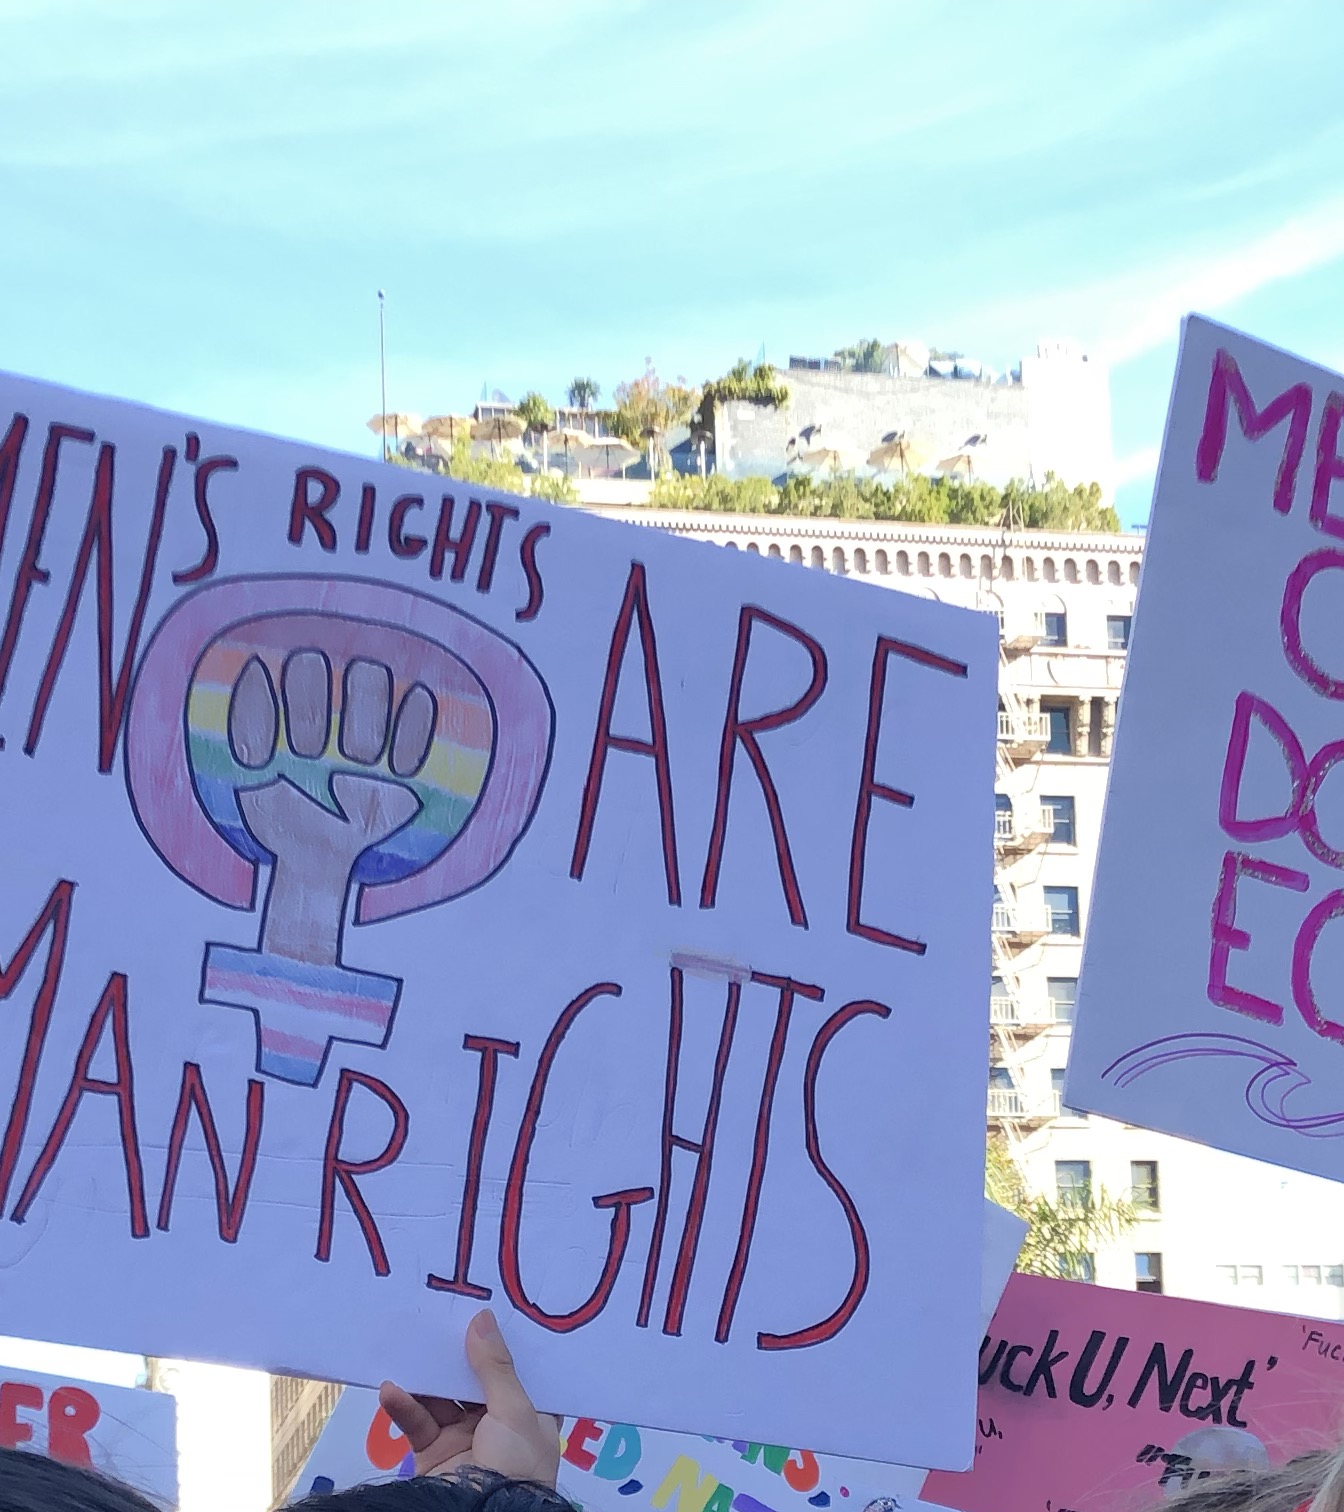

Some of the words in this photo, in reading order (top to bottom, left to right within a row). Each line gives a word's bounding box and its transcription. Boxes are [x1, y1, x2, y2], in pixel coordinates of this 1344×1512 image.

[288, 465, 552, 622] RIGHTS
[568, 560, 968, 955] ARE
[313, 964, 892, 1351] RIGHTS
